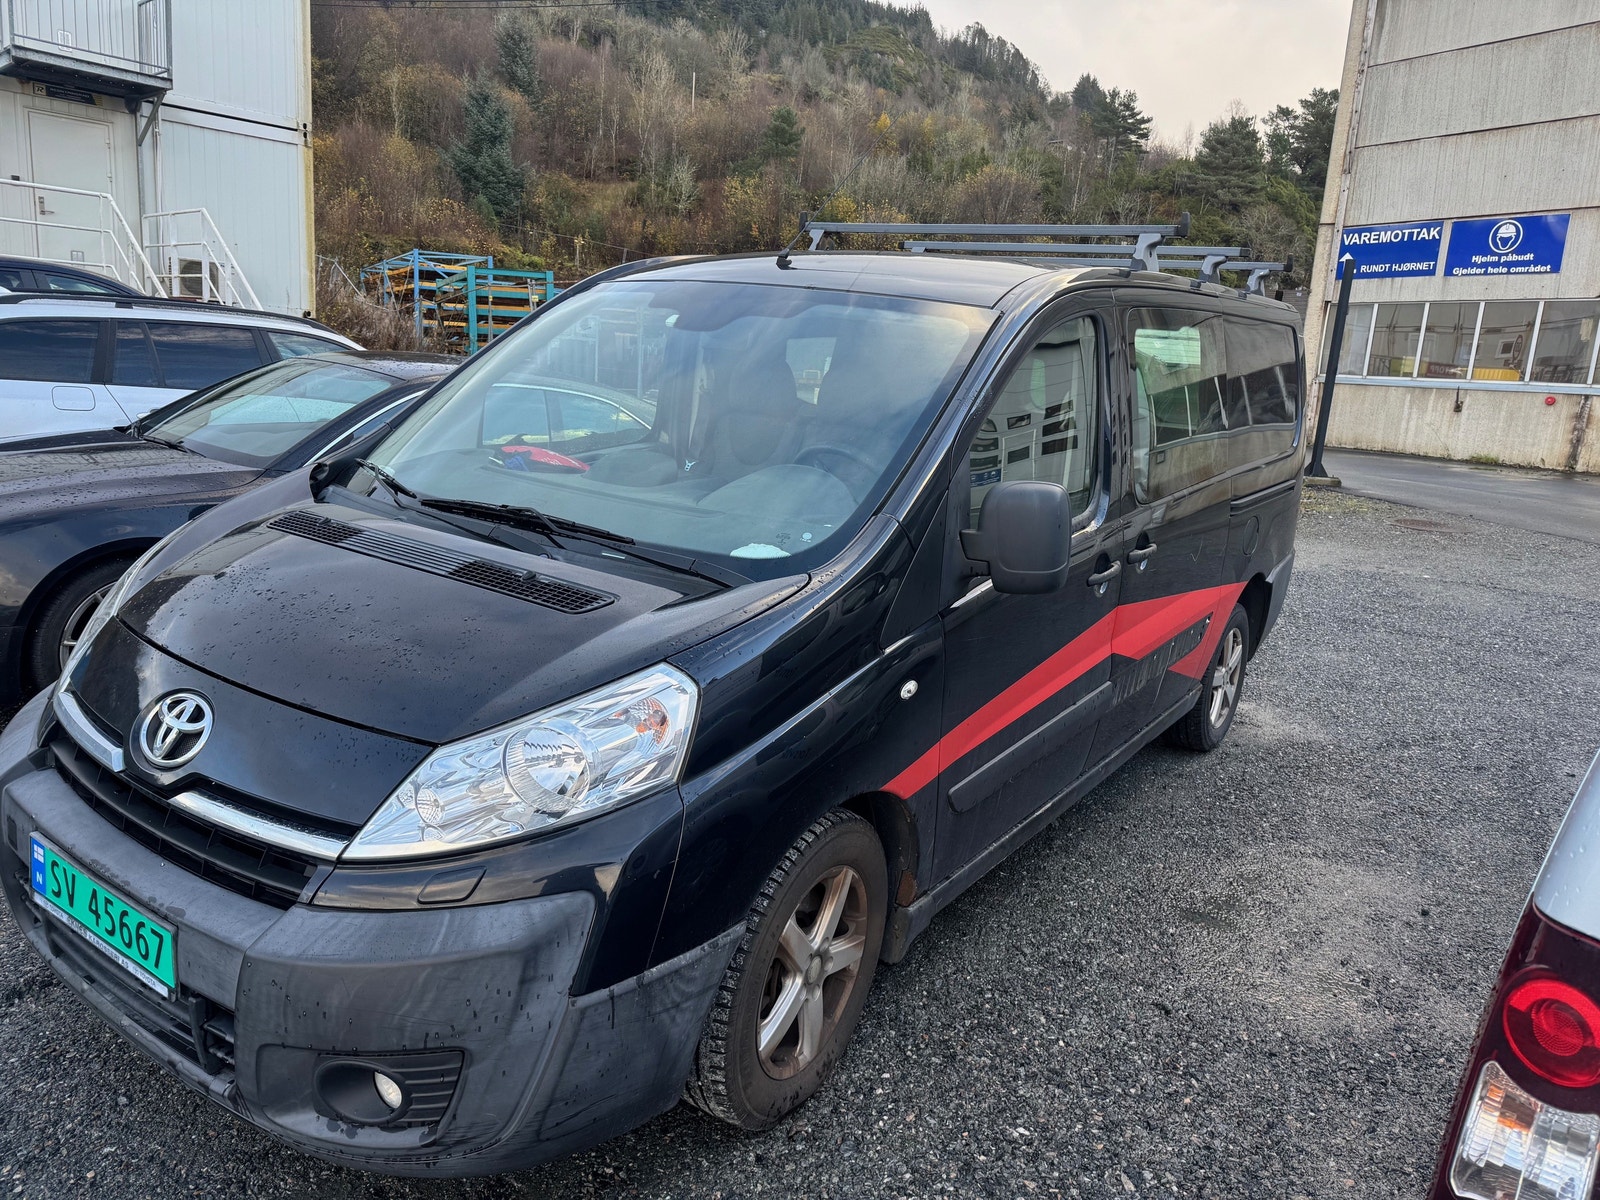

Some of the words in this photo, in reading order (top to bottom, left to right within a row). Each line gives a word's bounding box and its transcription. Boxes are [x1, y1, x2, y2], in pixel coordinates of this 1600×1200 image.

[1343, 227, 1441, 246] VAREMOTTAK
[1472, 255, 1498, 264] Hjelm
[1500, 253, 1534, 263] påbudt
[1360, 264, 1391, 273] RUNDT
[1392, 261, 1435, 272] HJØRNET
[1453, 267, 1486, 276] Gjelder
[1487, 266, 1508, 274] hele
[1510, 264, 1551, 273] området
[36, 871, 43, 885] N
[51, 860, 76, 908] SV
[88, 888, 164, 969] 45667
